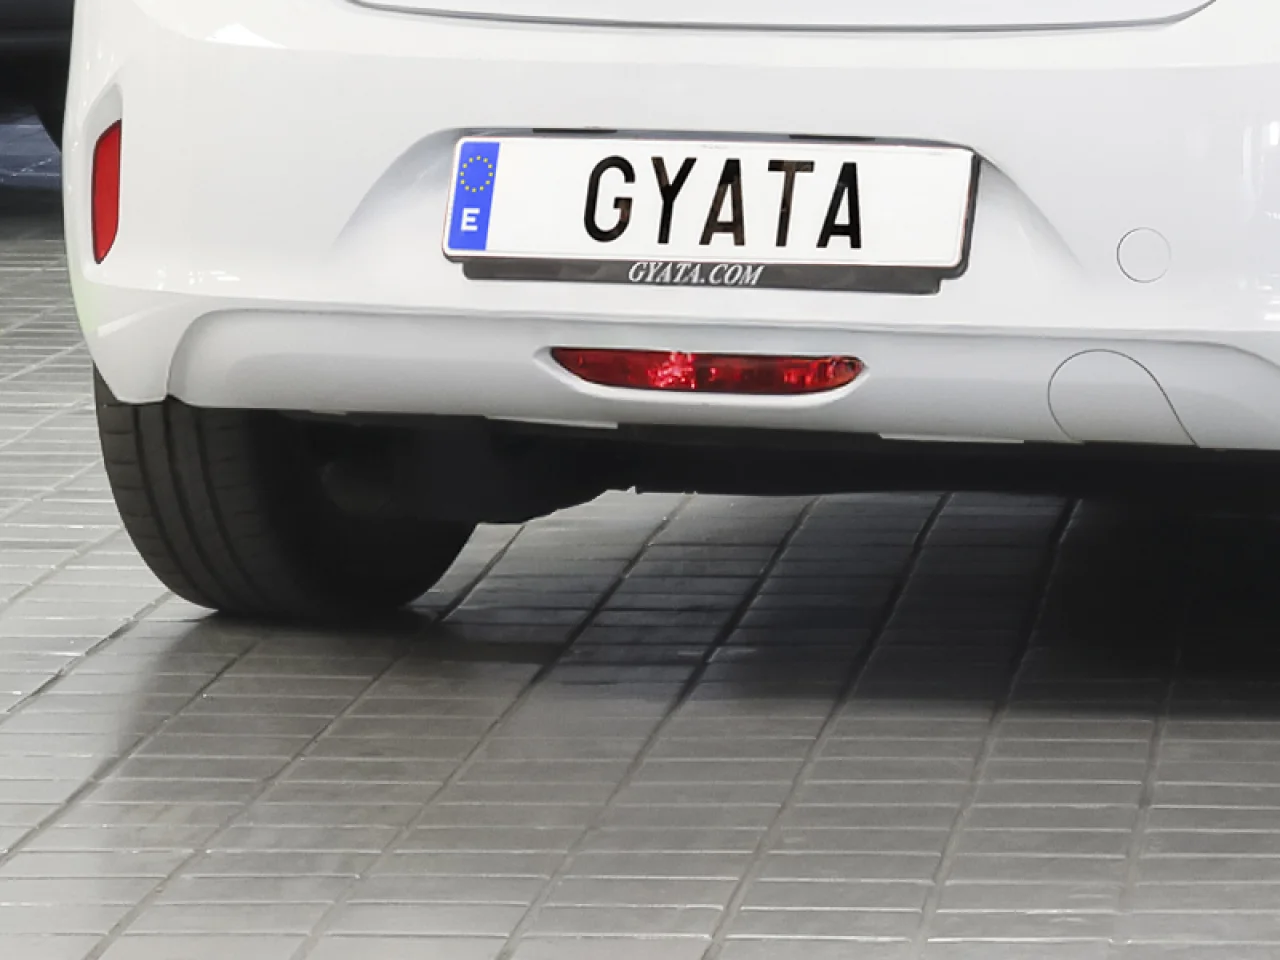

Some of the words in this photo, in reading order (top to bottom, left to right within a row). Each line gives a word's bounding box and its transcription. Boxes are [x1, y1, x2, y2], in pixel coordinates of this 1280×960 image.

[583, 155, 862, 249] GYATA
[461, 208, 480, 232] E
[628, 261, 765, 286] GYATA.COM
